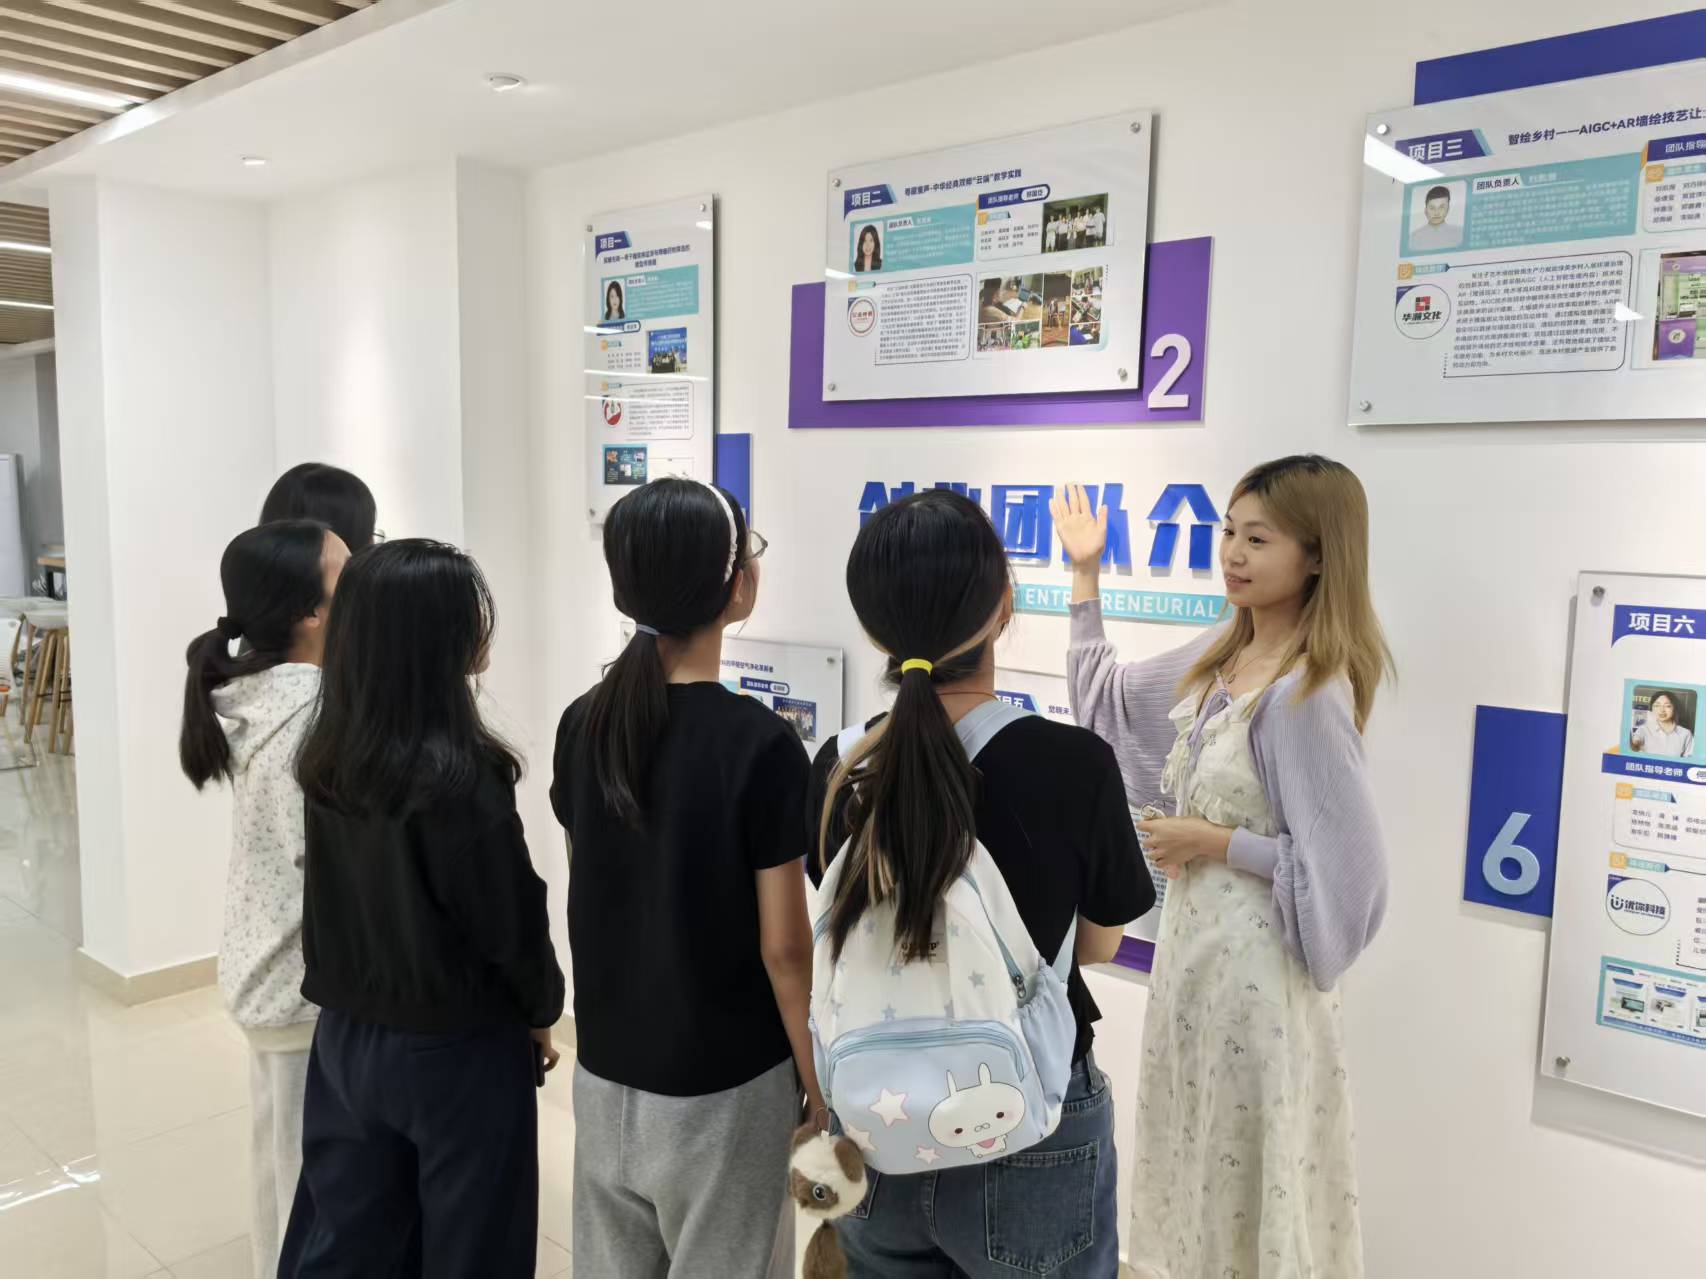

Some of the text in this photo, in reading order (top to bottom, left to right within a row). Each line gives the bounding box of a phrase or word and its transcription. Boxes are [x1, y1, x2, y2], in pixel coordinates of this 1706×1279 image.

[1508, 107, 1706, 145] 智绘乡村——AIGC+AR墙绘技艺让
[1408, 139, 1463, 160] 项目三
[1476, 176, 1519, 191] 团队负责人
[851, 191, 882, 206] 项目二
[600, 237, 622, 249] 项目一
[1147, 333, 1192, 409] 2
[858, 482, 1223, 569] 团队介
[1025, 588, 1218, 617] ENTRRENEURIAL
[1628, 612, 1696, 634] 项目六
[997, 695, 1025, 709] 目五
[1625, 762, 1683, 777] 团队指导老师
[1482, 811, 1541, 895] 6
